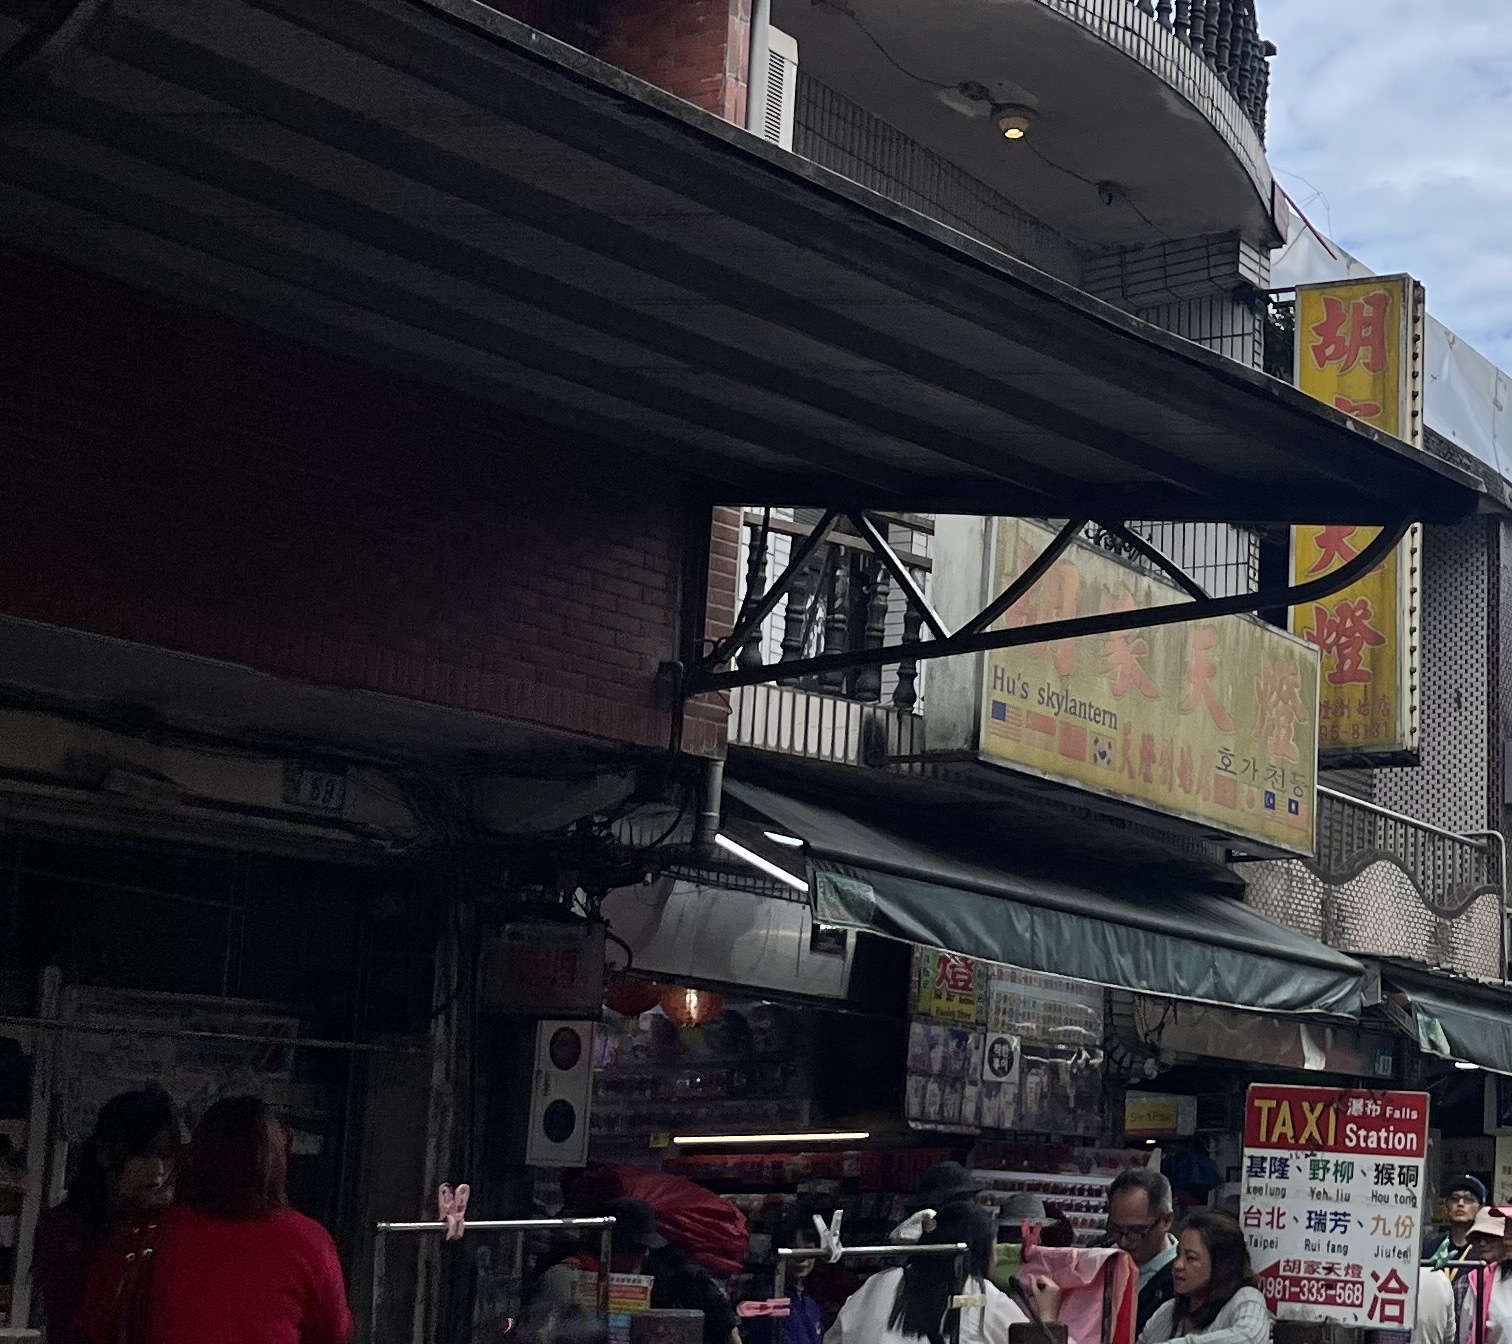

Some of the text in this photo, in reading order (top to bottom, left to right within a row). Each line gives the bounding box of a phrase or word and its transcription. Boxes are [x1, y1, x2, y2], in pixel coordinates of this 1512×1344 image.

[992, 664, 1118, 731] Hu's skylantern
[1215, 746, 1308, 799] 호가천등
[1254, 1099, 1337, 1146] TAXI
[1385, 1107, 1418, 1120] Falls
[1345, 1123, 1418, 1151] Station
[1371, 1190, 1390, 1203] Hou
[1248, 1234, 1409, 1260] Taipei Rui fang Jiufen
[1282, 1259, 1363, 1279] 胡家天燈
[1260, 1276, 1363, 1305] 0981-333-568
[1367, 1267, 1409, 1324] 洽
